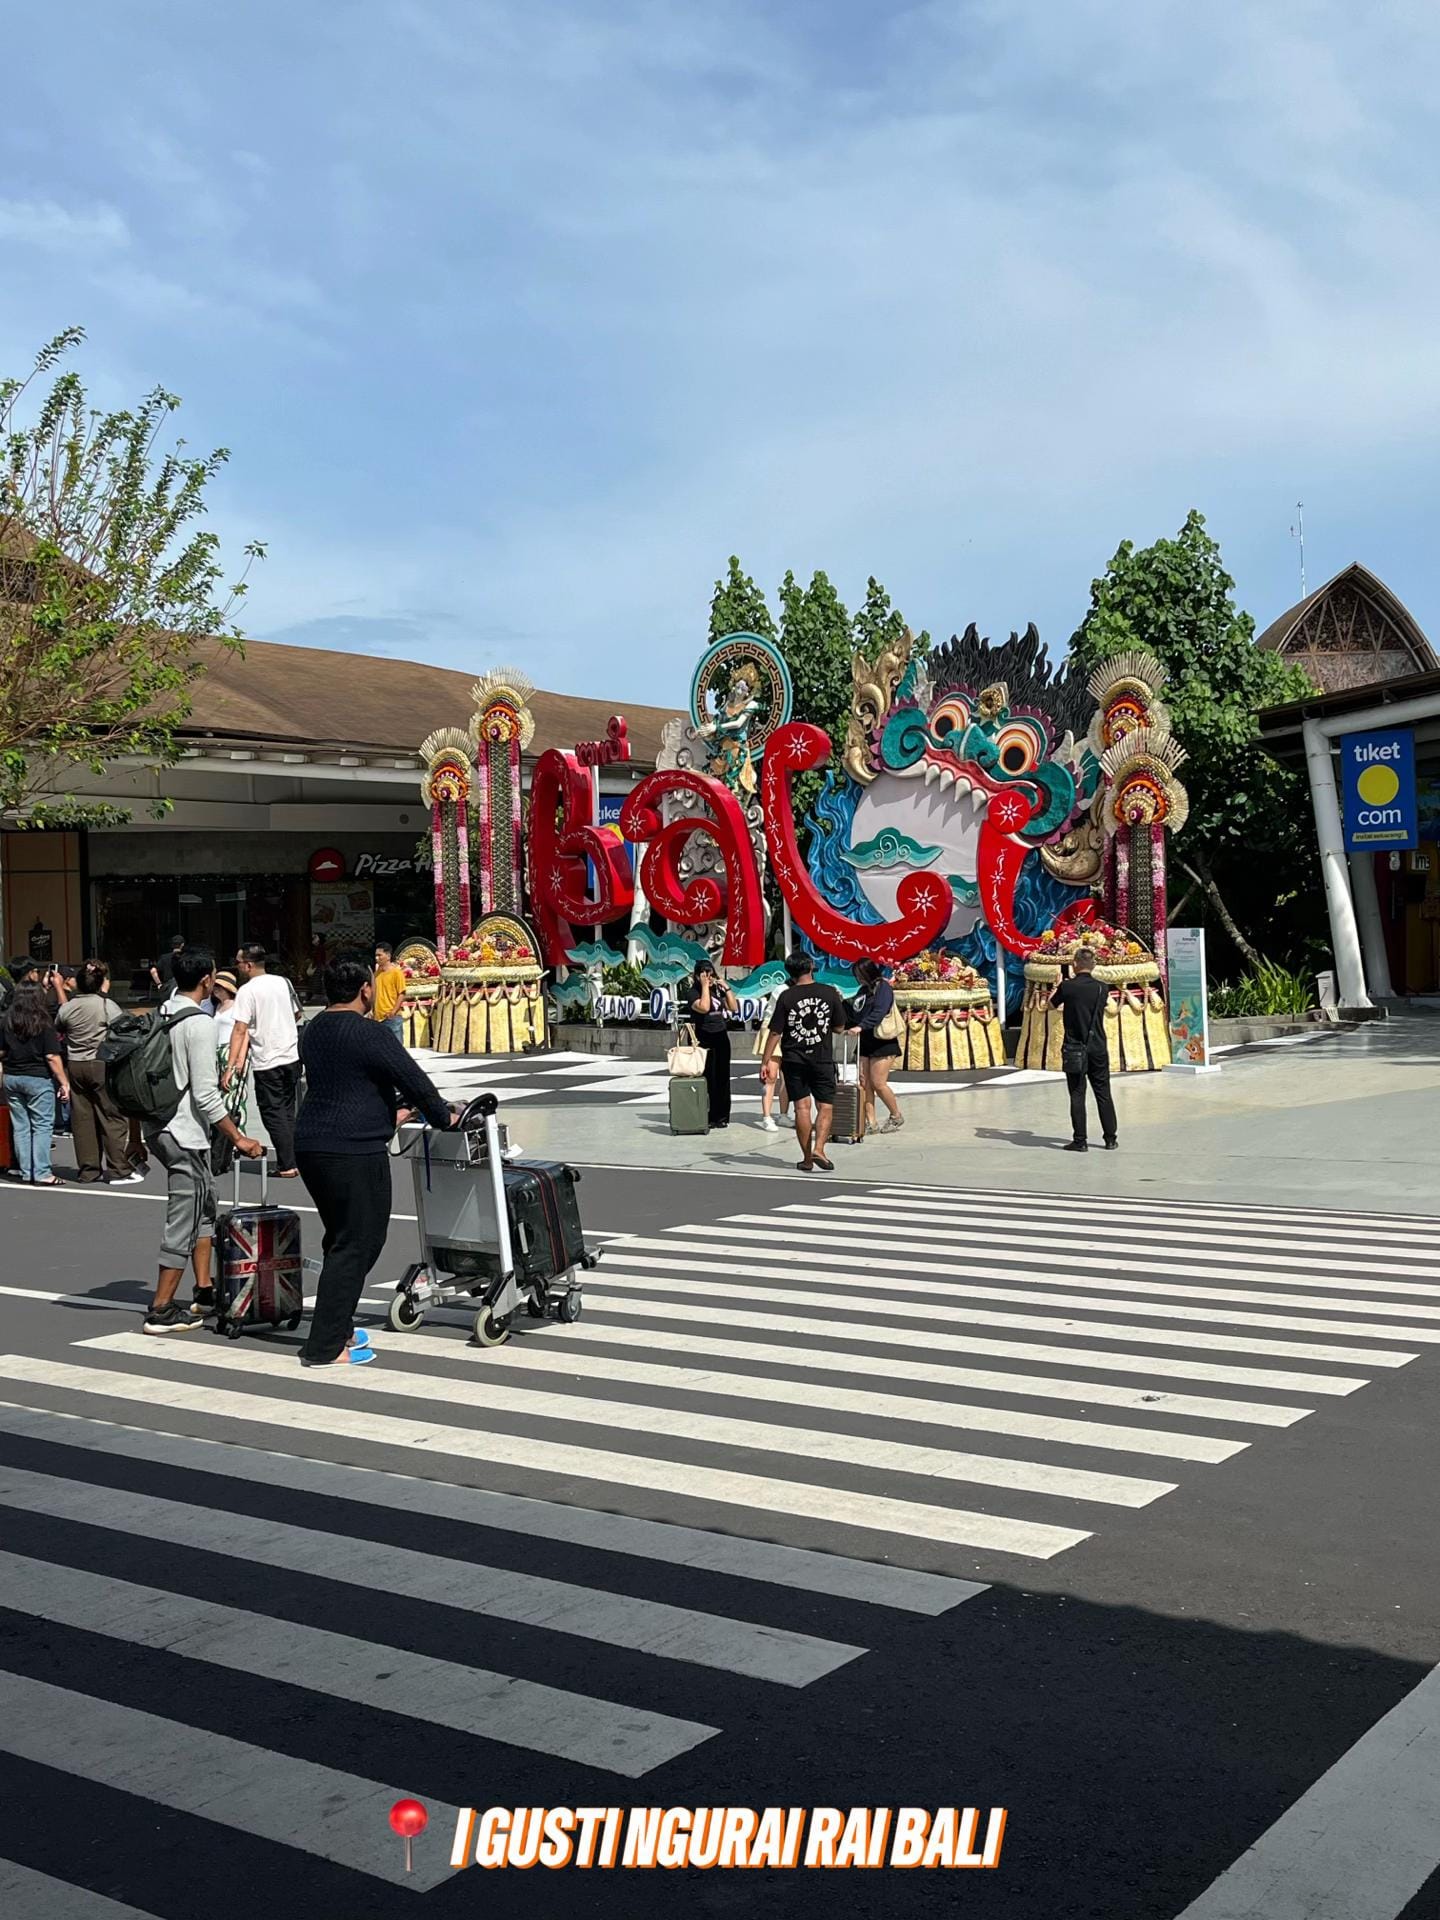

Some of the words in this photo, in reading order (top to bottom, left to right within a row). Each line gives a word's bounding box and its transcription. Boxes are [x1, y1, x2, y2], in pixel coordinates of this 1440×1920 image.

[1354, 742, 1401, 762] tiket
[1357, 809, 1402, 825] com
[355, 853, 412, 876] Pizza
